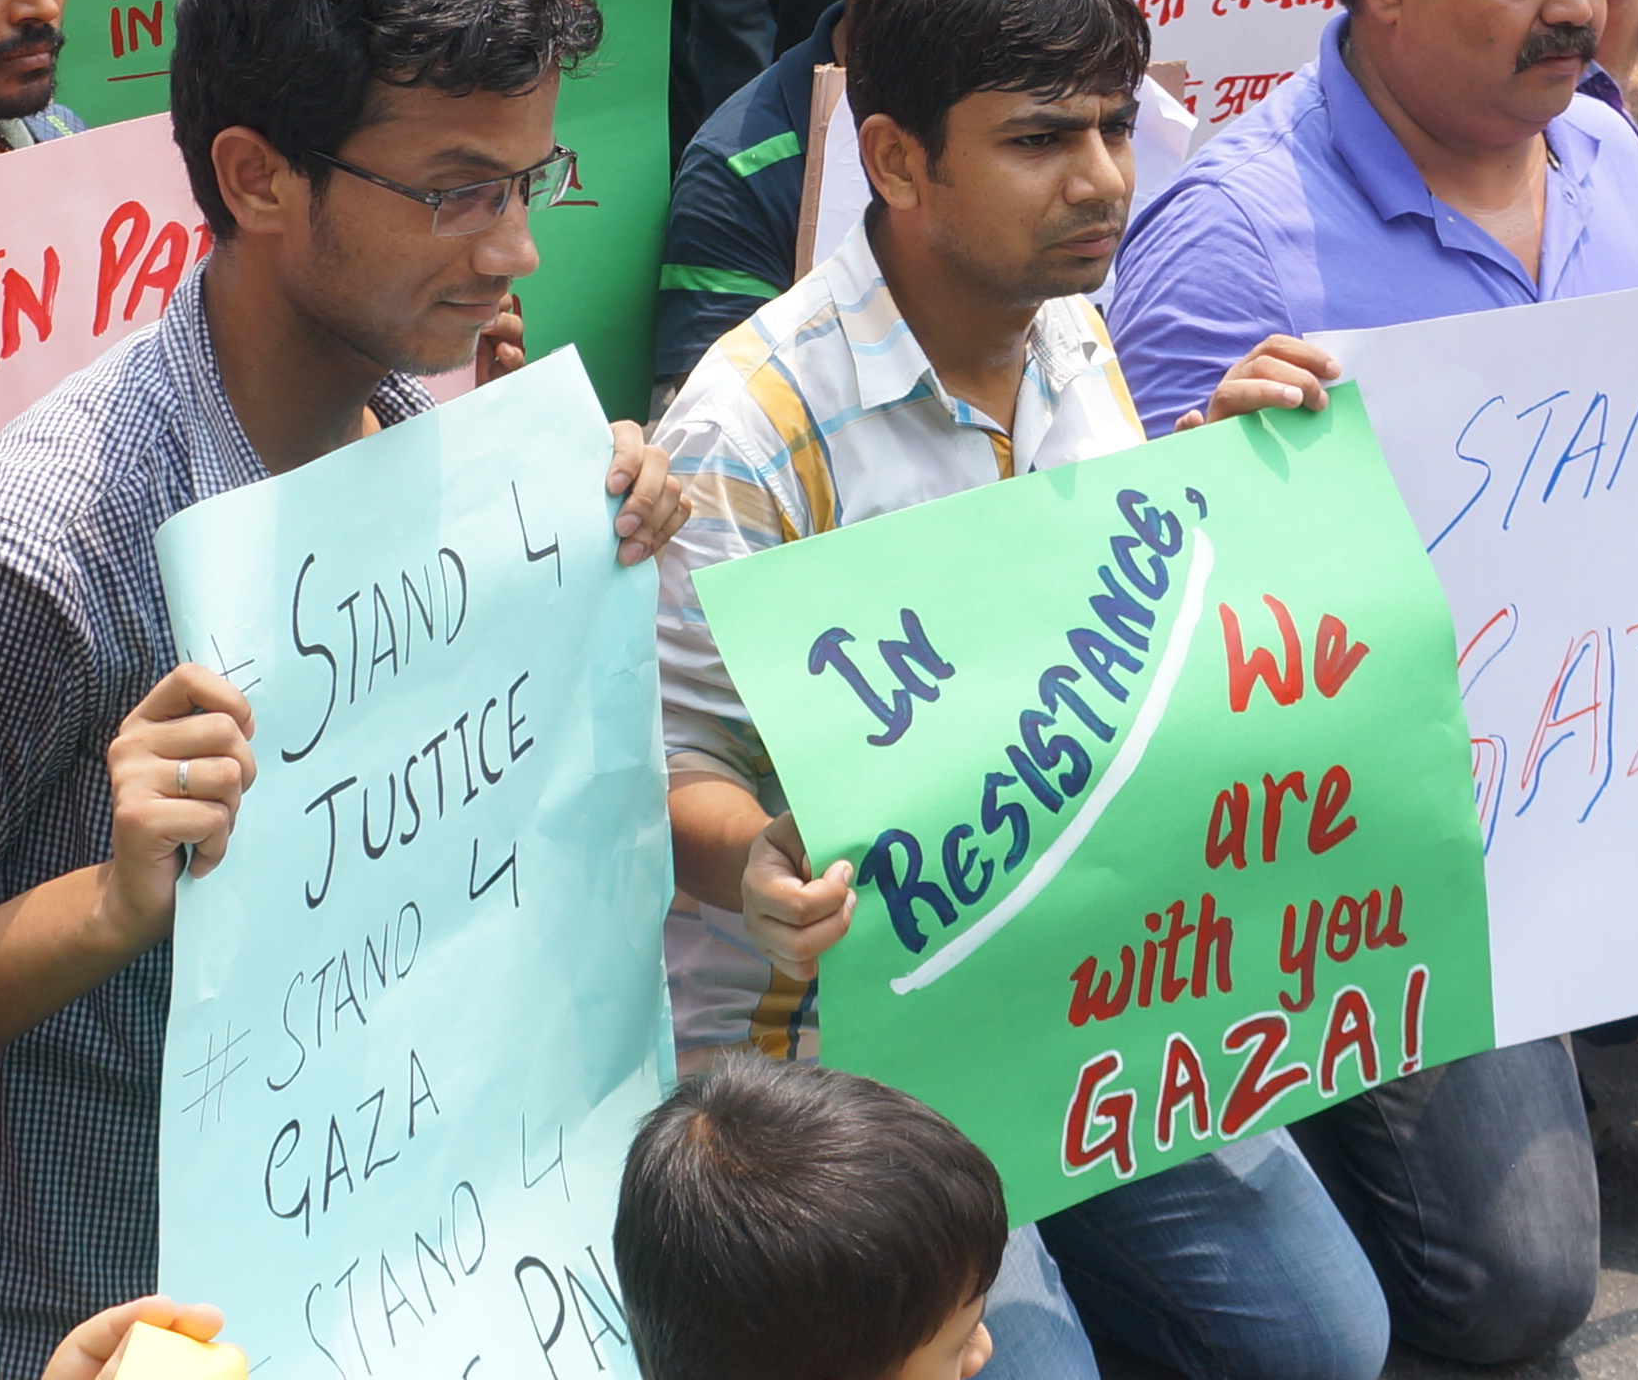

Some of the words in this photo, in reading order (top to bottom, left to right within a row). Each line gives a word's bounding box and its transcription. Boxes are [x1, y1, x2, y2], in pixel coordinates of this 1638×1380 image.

[283, 548, 468, 763] STAND
[512, 480, 563, 587] 4
[1218, 593, 1370, 712] We
[305, 670, 535, 911] JUSTICE
[1205, 764, 1357, 871] are
[468, 840, 521, 911] 4
[1068, 892, 1233, 1028] with
[1279, 884, 1407, 1014] you
[263, 1050, 441, 1237] GAZA
[1062, 966, 1428, 1179] GAZA!
[522, 1113, 571, 1203] 4
